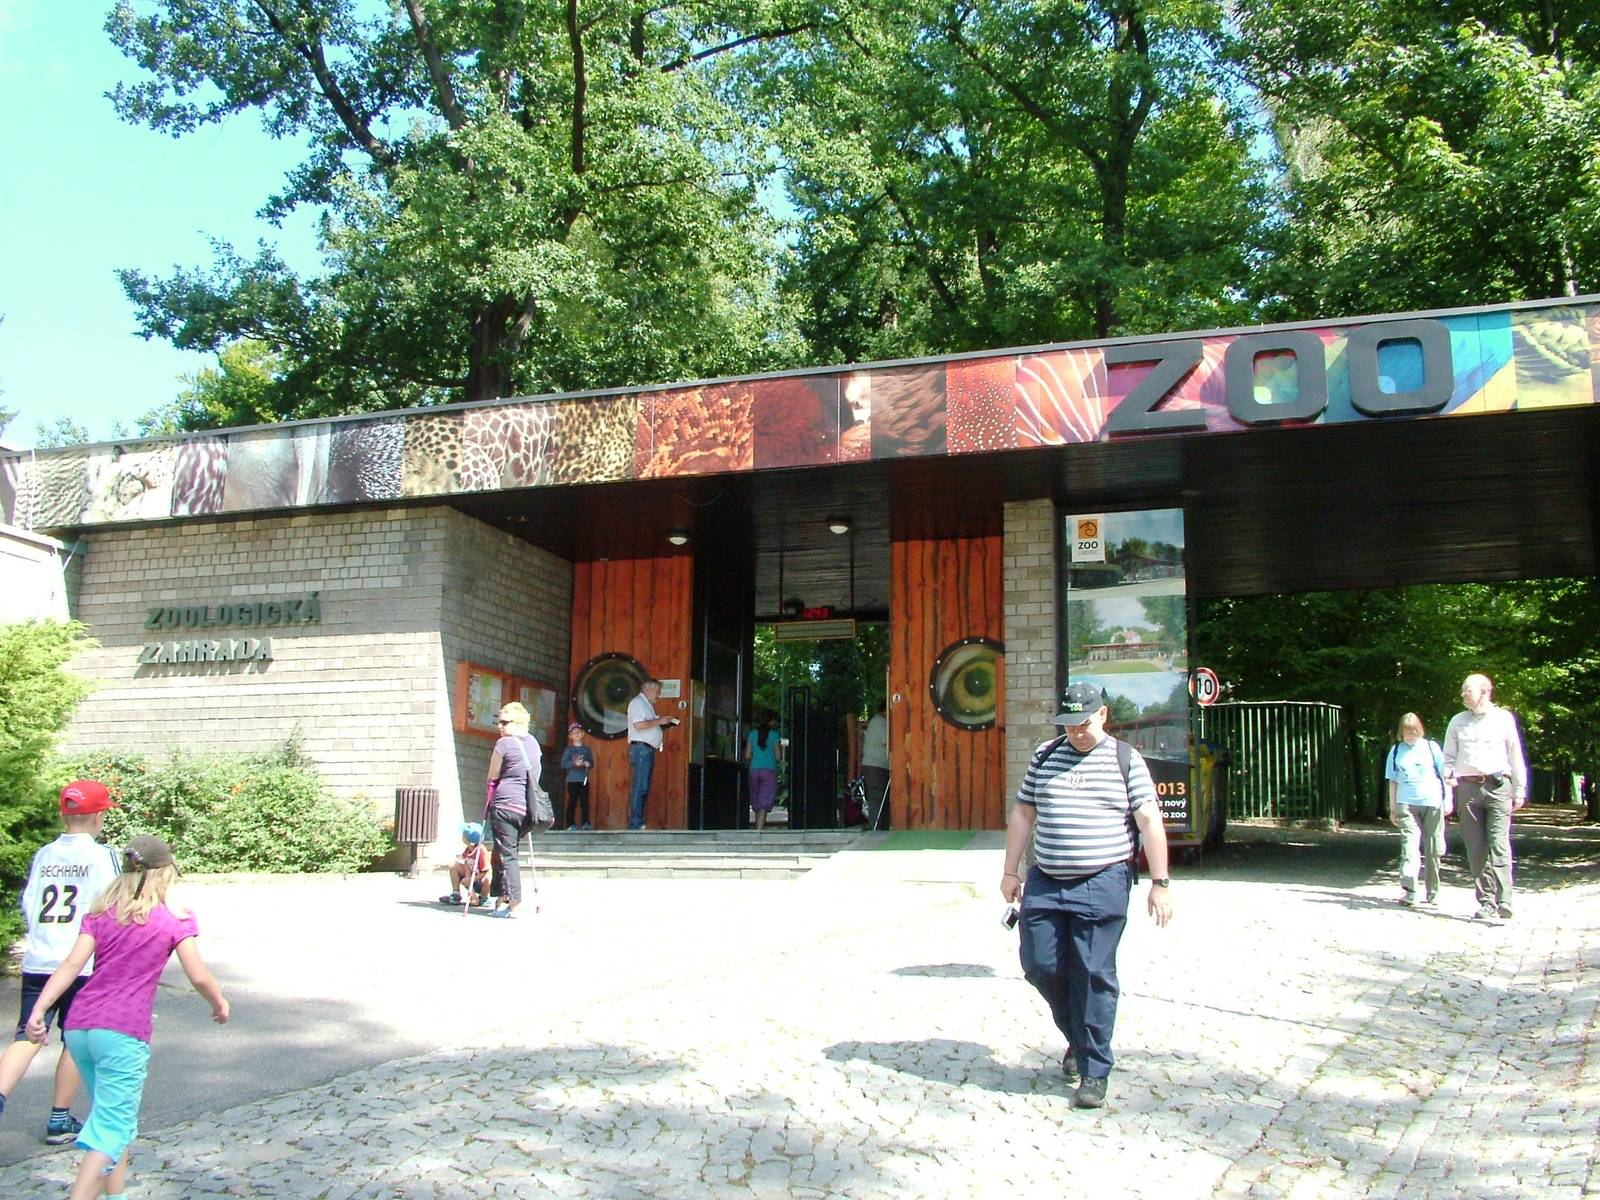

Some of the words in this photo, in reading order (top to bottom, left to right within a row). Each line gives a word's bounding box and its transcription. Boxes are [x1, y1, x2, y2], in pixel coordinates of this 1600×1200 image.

[1103, 319, 1454, 438] ZOO
[1078, 541, 1098, 550] ZOO
[144, 591, 321, 630] ZOOLOGICKÁ
[137, 637, 273, 664] ZAHRADA
[1197, 678, 1212, 695] 10
[1154, 782, 1186, 795] 013
[1164, 798, 1187, 808] nový
[1170, 811, 1187, 819] zoo
[41, 865, 89, 878] BECKHAM
[39, 884, 78, 923] 23
